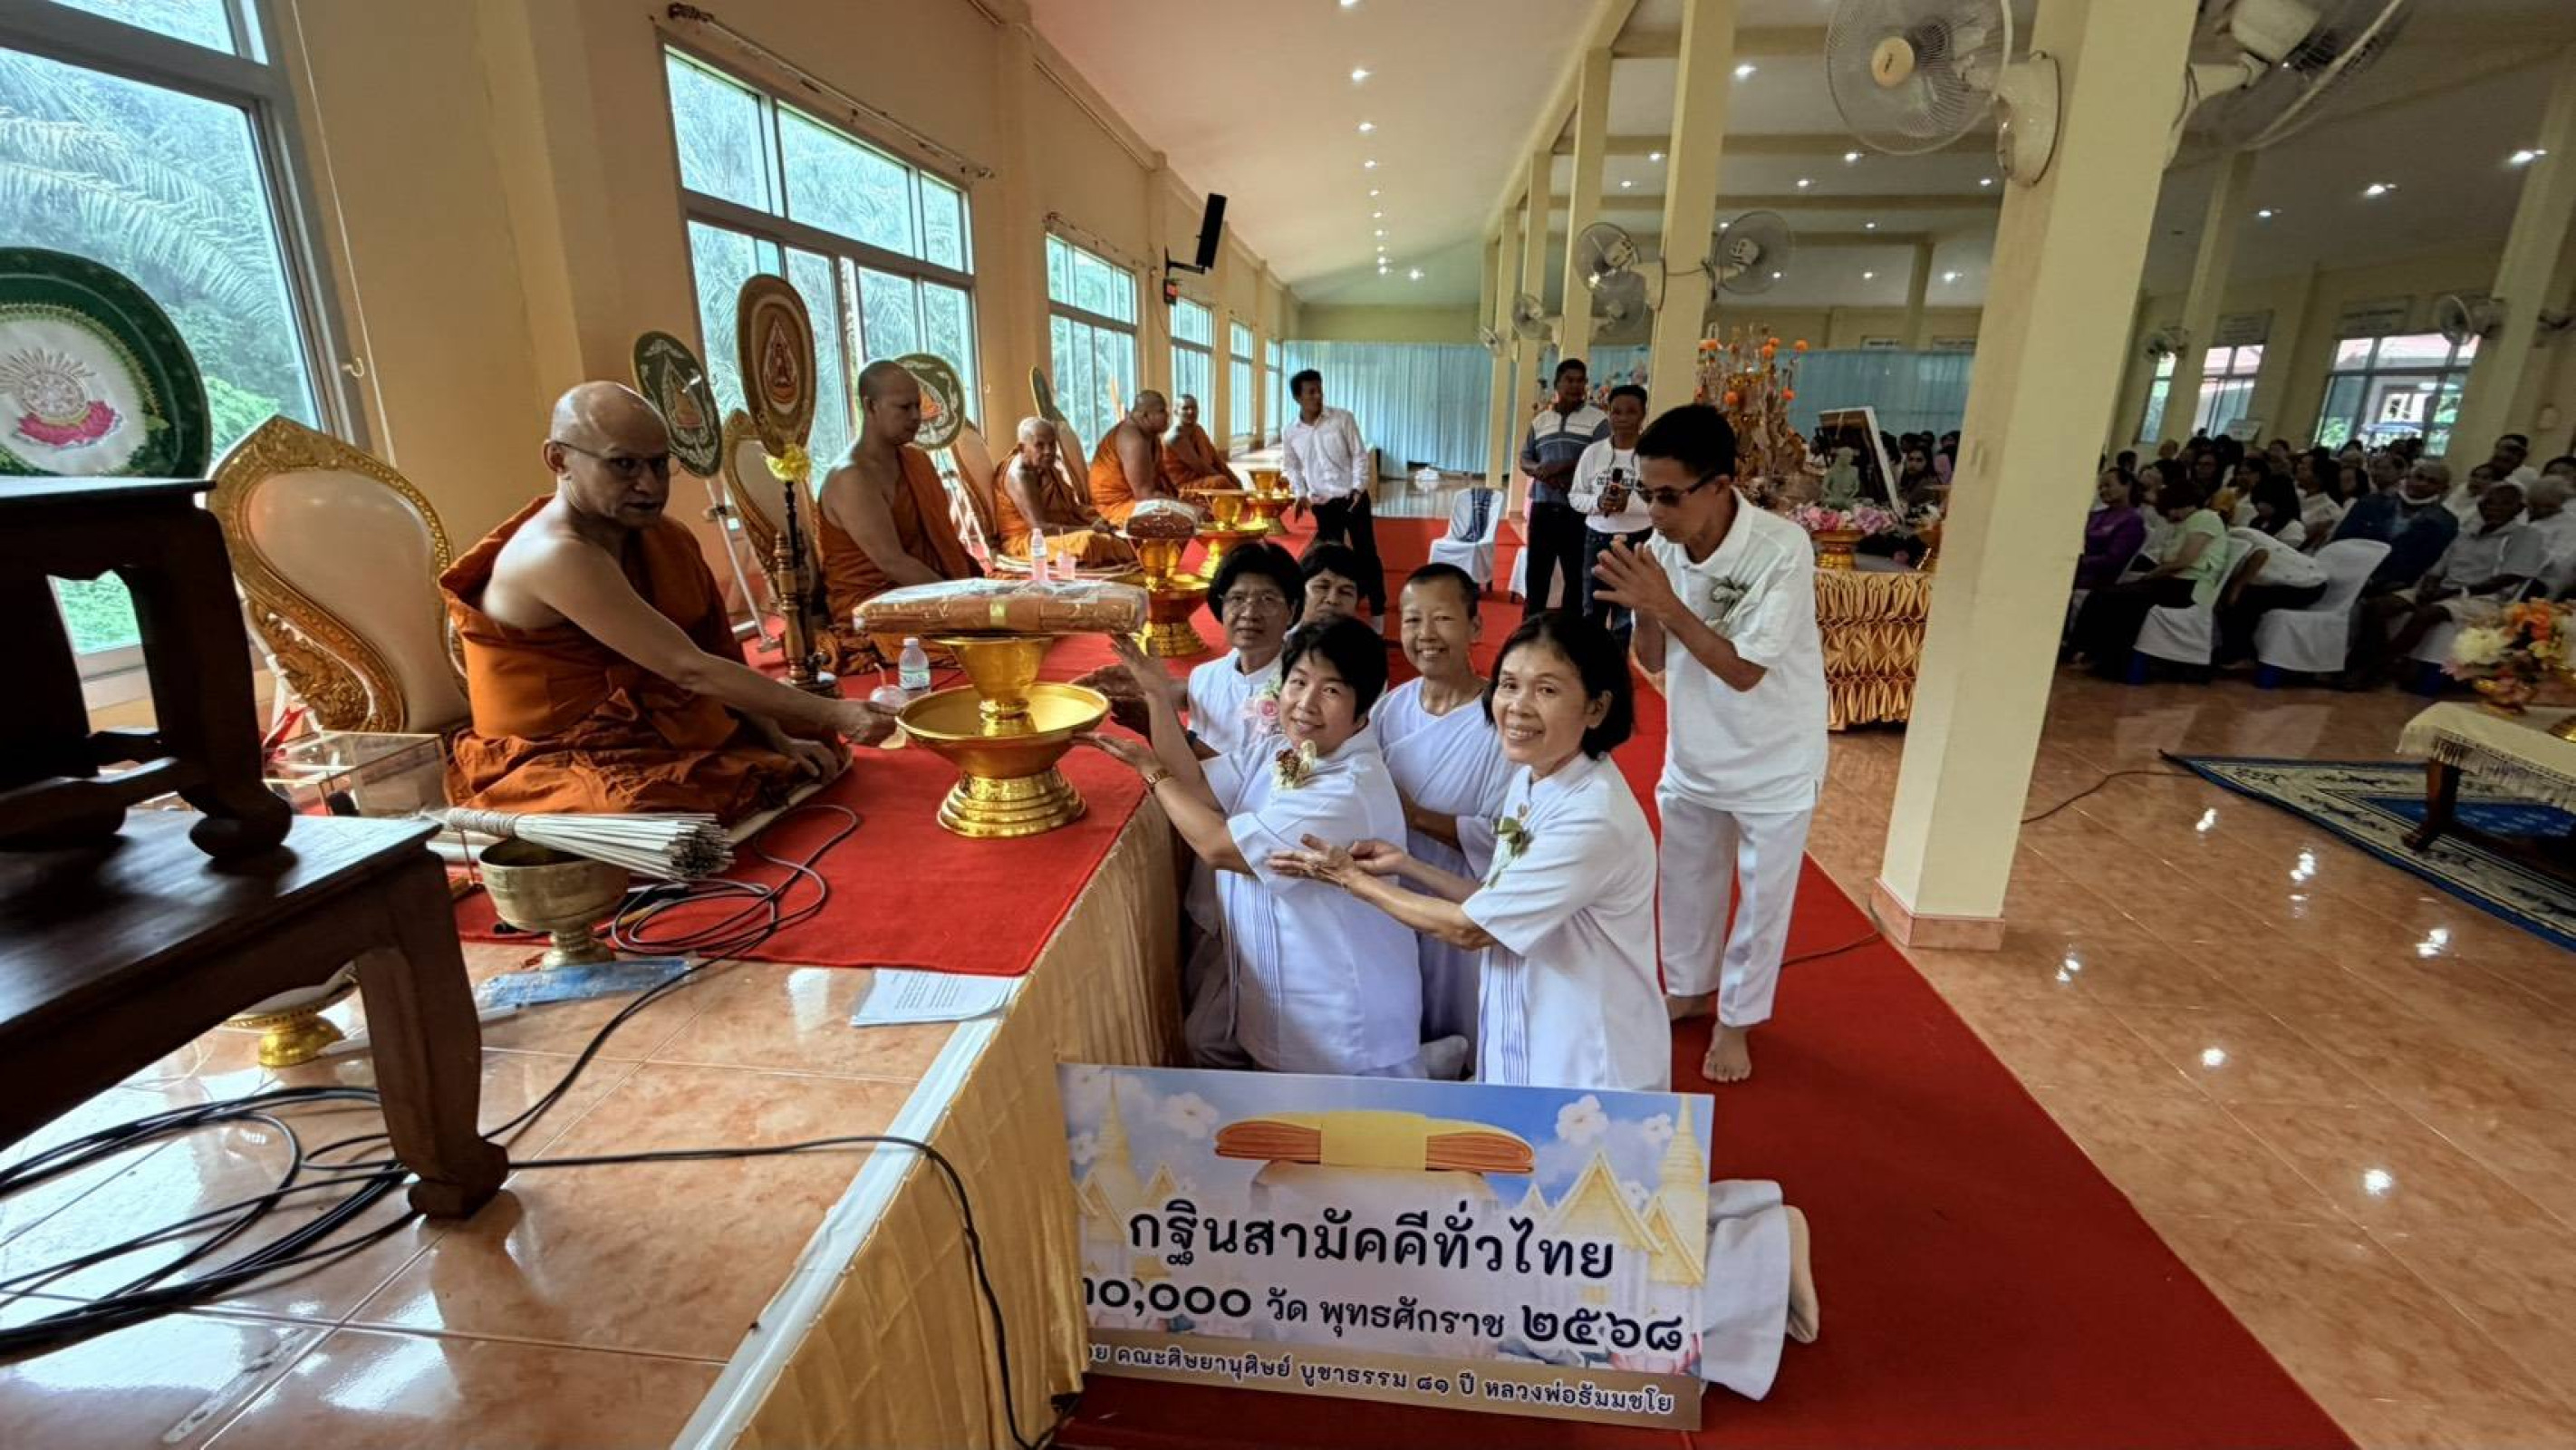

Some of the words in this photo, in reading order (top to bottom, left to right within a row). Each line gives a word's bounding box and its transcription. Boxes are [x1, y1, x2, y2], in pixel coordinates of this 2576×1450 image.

[1130, 1198, 1614, 1279] กฐินสามัคคีทั่วไทย
[1267, 1286, 1308, 1322] วัด
[1319, 1295, 1505, 1338] พุทธศักราช
[1521, 1304, 1684, 1351] ๒๕๖๘
[1117, 1346, 1292, 1380] คณะศิษยานุศิษย์
[1300, 1364, 1407, 1387] บูชาธรรม
[1459, 1372, 1475, 1395] ปี
[1484, 1380, 1673, 1412] หลวงพ่อธัมมชโย
